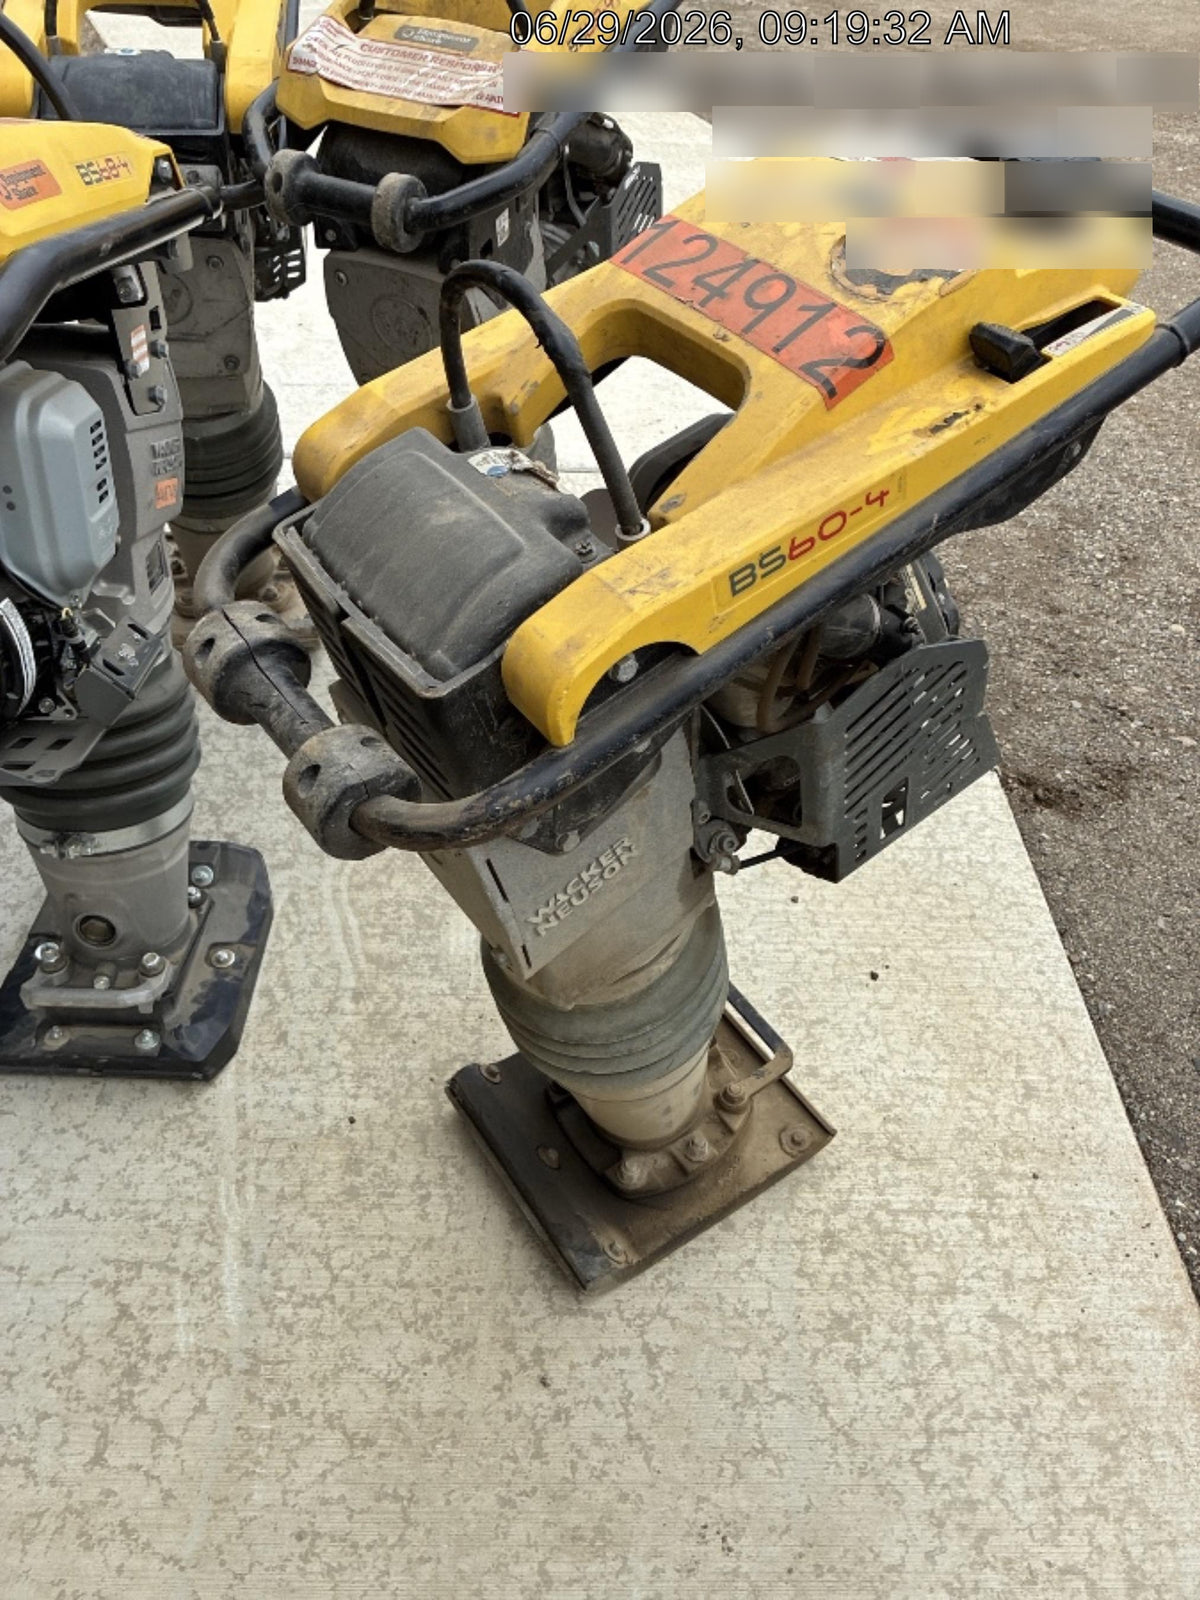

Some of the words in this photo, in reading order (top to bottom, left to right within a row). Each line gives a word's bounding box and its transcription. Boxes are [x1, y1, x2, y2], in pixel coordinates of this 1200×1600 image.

[620, 219, 886, 399] 124912
[728, 489, 890, 598] BS60-4
[527, 837, 635, 924] WACKER
[535, 845, 641, 938] NEUSON
